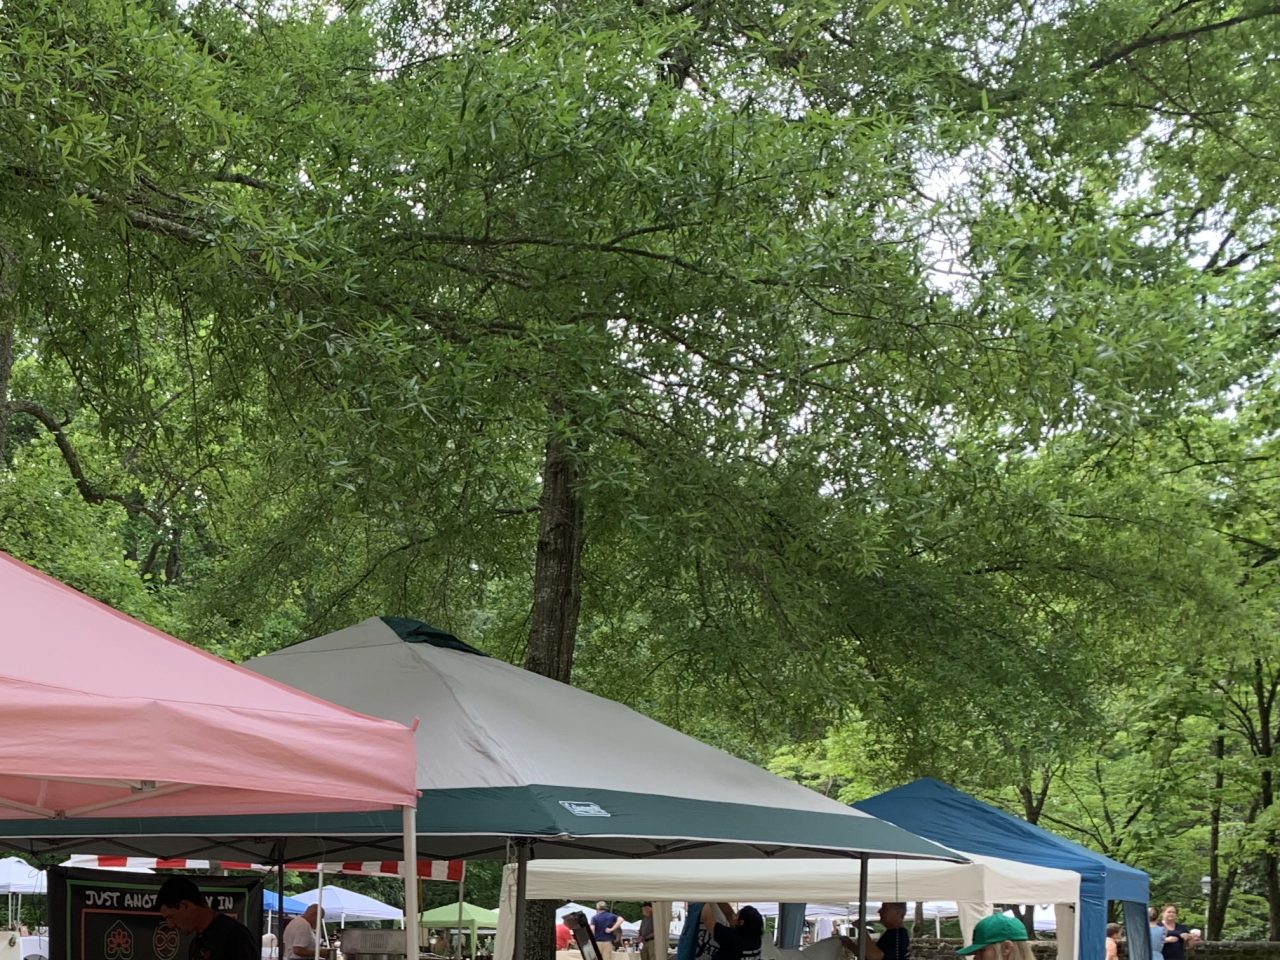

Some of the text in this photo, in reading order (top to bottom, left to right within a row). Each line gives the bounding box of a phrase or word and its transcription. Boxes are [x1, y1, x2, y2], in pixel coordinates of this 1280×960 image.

[85, 891, 120, 906] JUST
[124, 893, 158, 908] ANOT
[217, 896, 234, 910] IN
